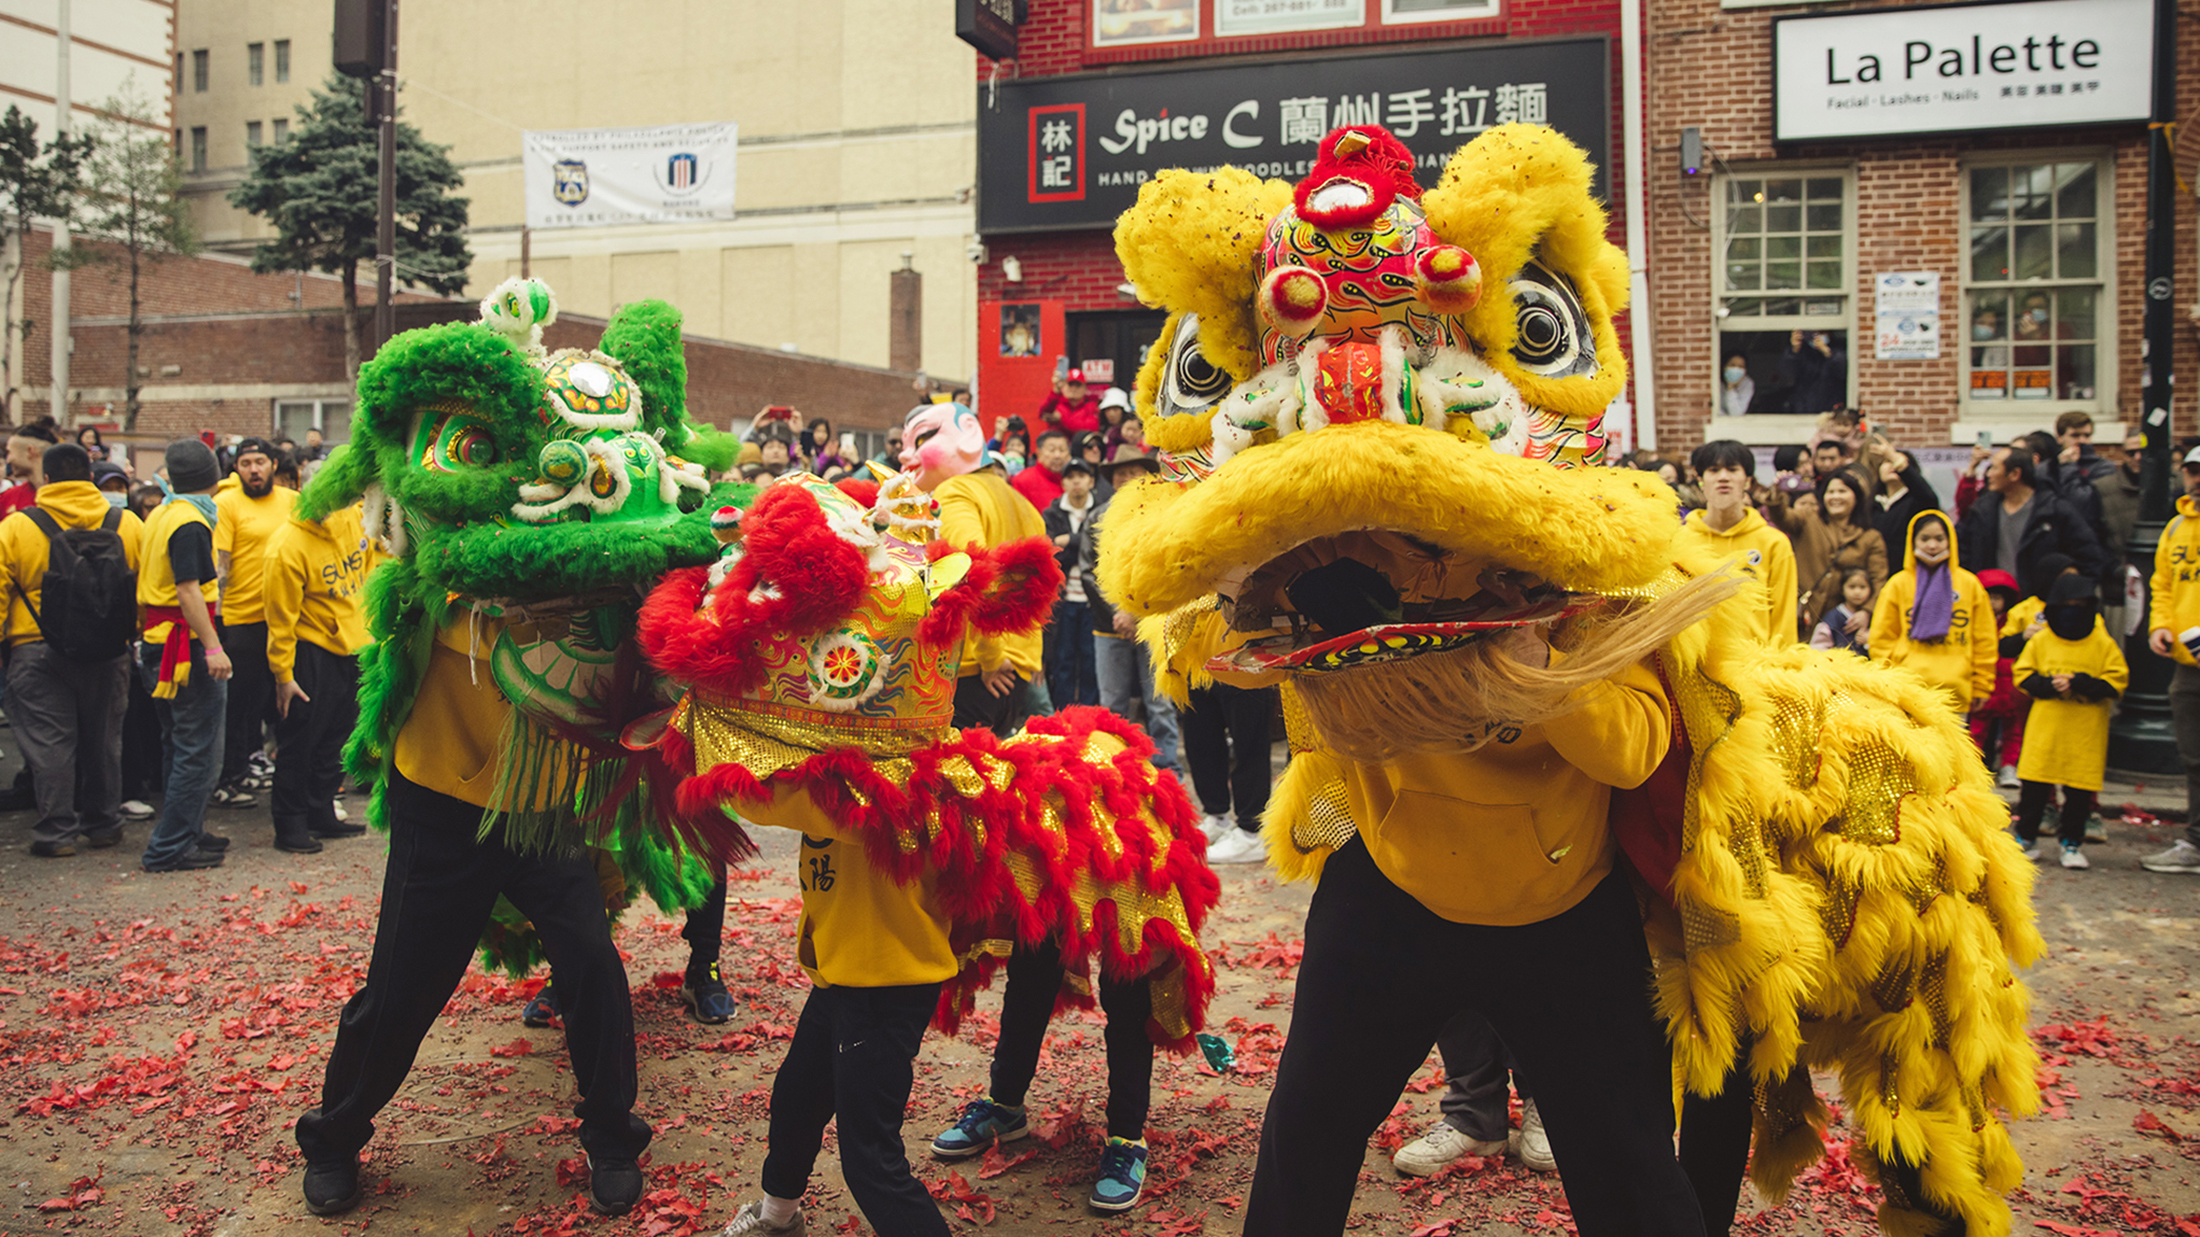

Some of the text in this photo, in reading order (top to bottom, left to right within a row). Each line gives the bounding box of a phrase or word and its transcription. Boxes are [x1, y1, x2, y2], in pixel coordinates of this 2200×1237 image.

[1827, 35, 2100, 84] La Palette
[1827, 89, 1979, 109] Facial Lashes Nails
[1041, 119, 1072, 187] 林記
[1099, 100, 1264, 155] Spice C
